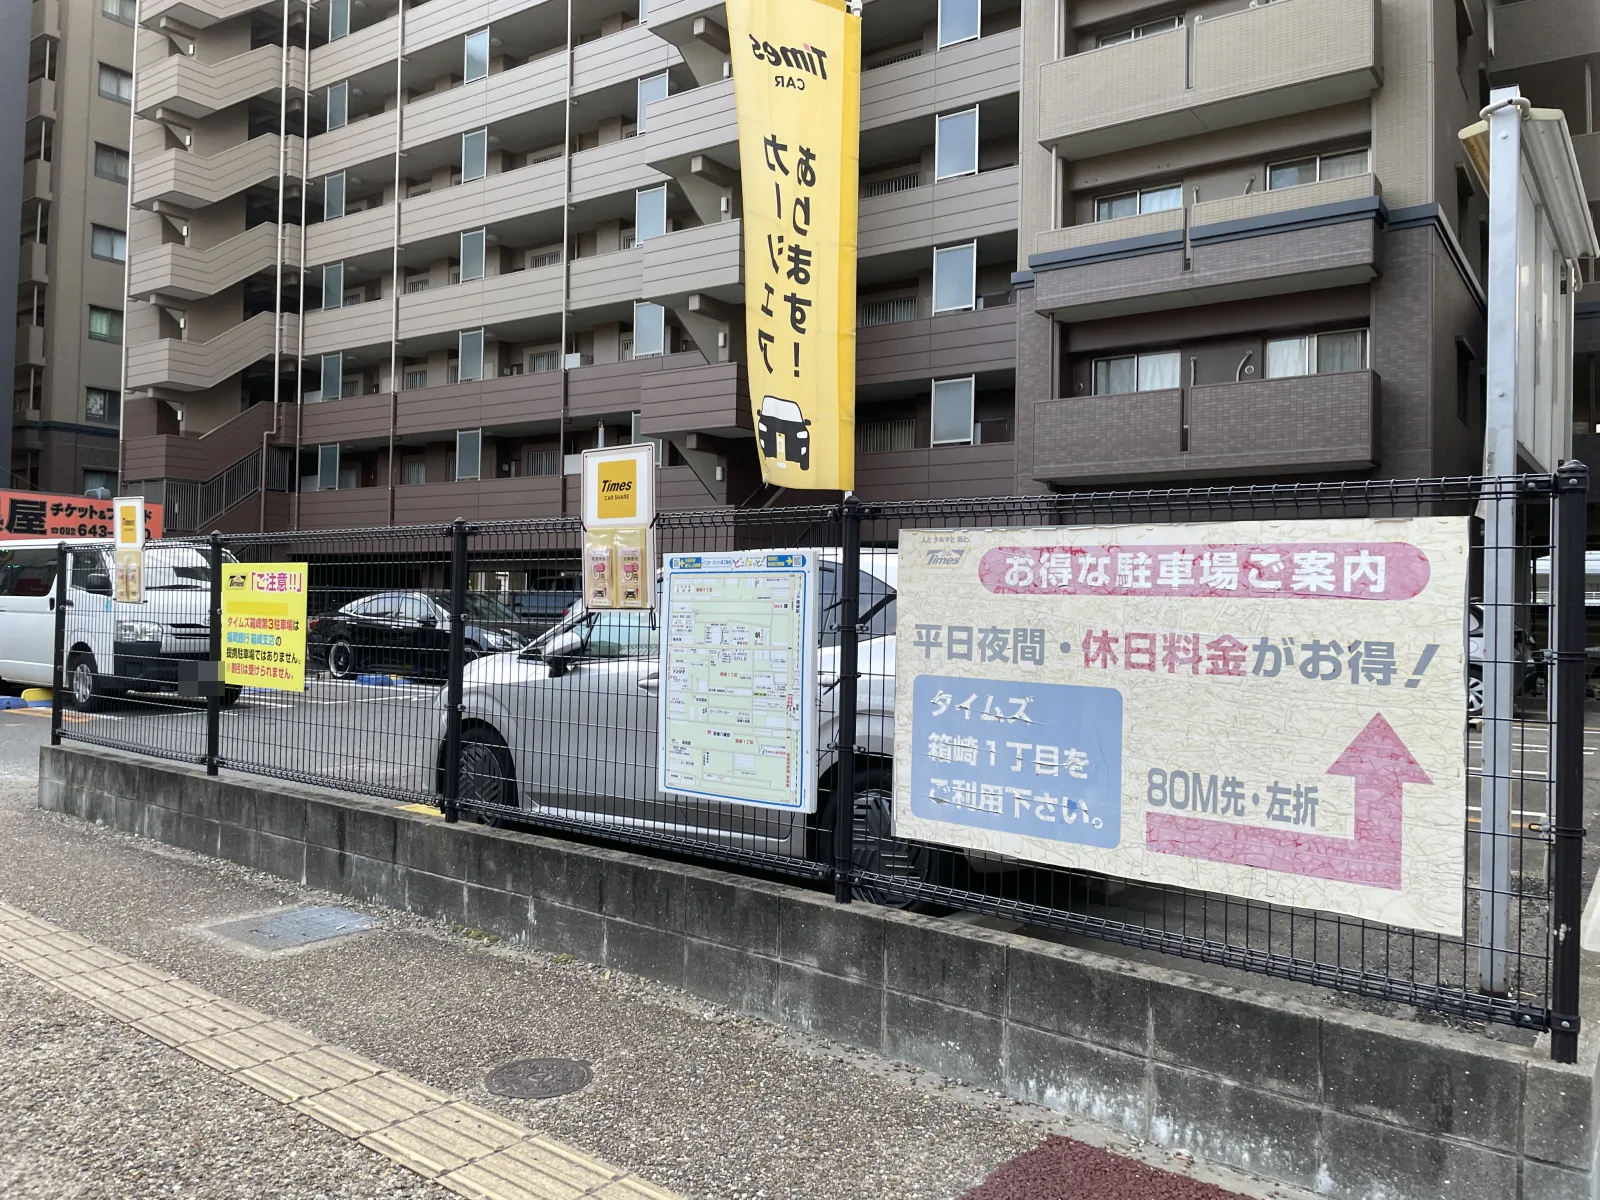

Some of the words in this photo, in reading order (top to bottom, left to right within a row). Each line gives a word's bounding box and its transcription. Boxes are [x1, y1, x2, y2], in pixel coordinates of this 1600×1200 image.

[601, 479, 632, 493] Times
[0, 497, 47, 536] 屋
[60, 526, 76, 535] 092
[927, 555, 961, 566] Times
[1004, 550, 1386, 592] お得な駐車場ご案内
[229, 578, 245, 588] Times
[227, 647, 301, 664] 提携駐車場ではありません。
[930, 690, 1034, 725] タイムズ
[927, 732, 1089, 779] 箱崎1丁目を
[929, 777, 1104, 829] ご利用下さい。
[1147, 768, 1318, 827] 80M先・左折
